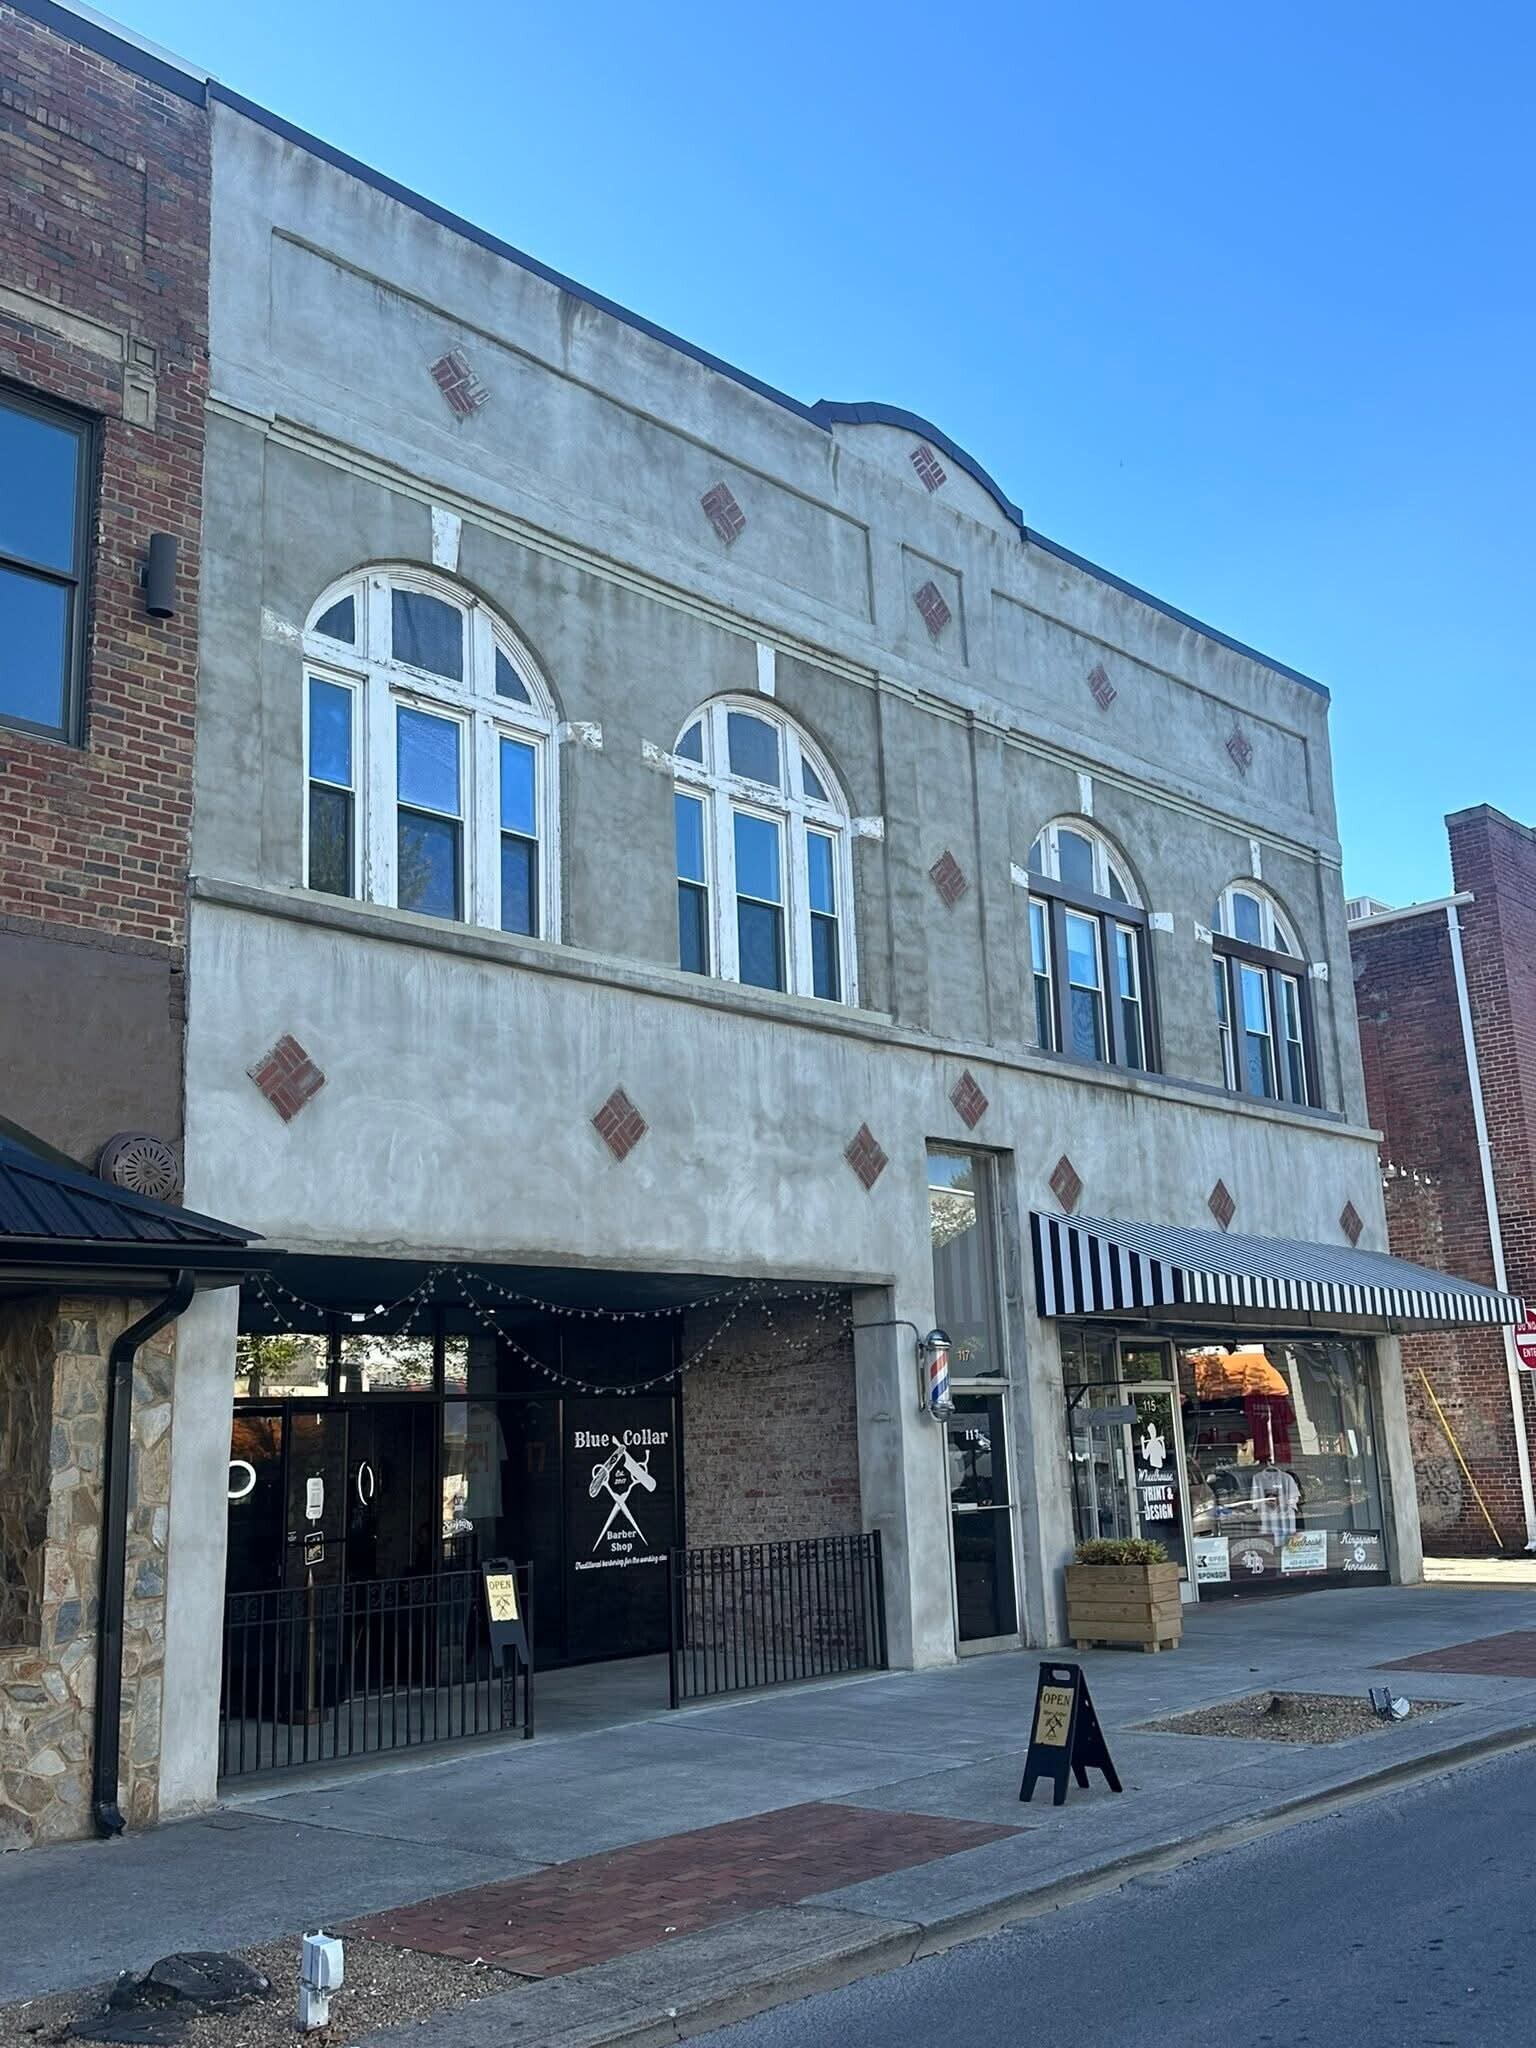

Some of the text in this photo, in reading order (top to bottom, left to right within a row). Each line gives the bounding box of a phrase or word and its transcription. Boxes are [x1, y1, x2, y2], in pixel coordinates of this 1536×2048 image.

[1143, 1400, 1156, 1412] 115
[574, 1428, 668, 1448] Blue Collar
[1166, 1486, 1174, 1500] &
[1144, 1503, 1174, 1521] DESIGN
[606, 1530, 637, 1540] Barber
[1340, 1531, 1378, 1547] Kingsport
[610, 1542, 633, 1553] Shop
[1343, 1558, 1378, 1571] Tennessee
[489, 1581, 512, 1590] OPEN
[1043, 1692, 1071, 1706] OPEN
